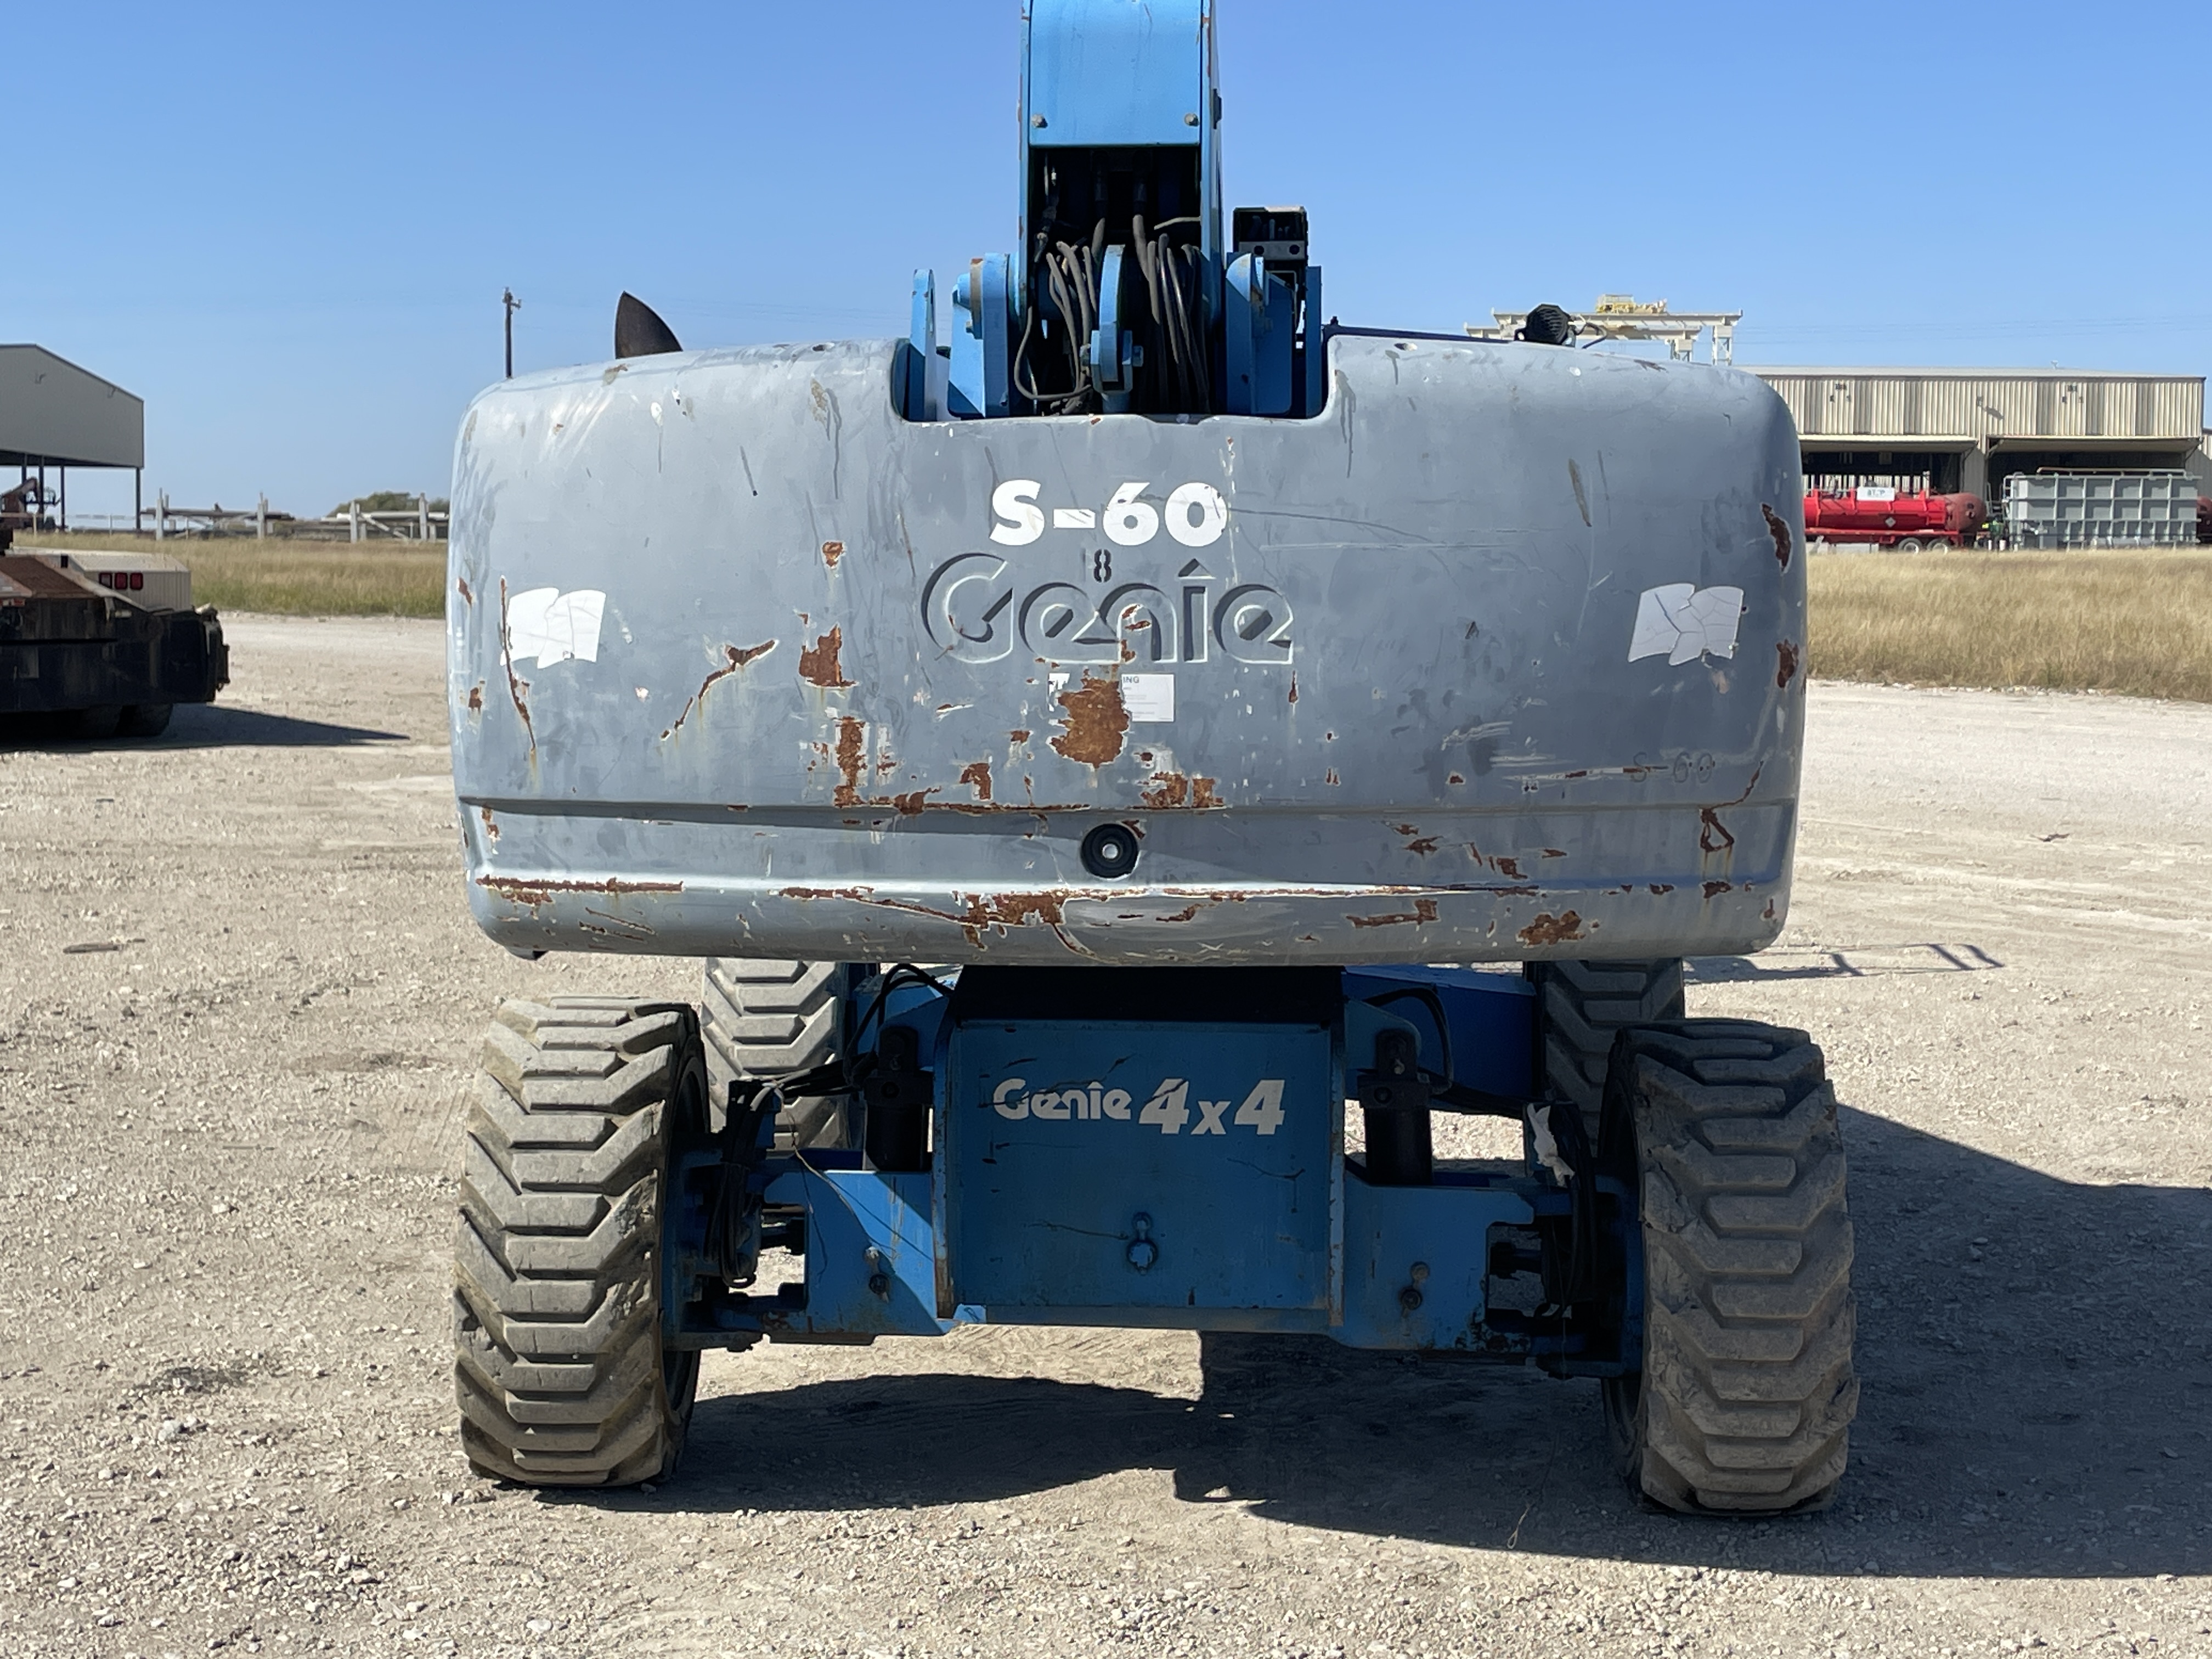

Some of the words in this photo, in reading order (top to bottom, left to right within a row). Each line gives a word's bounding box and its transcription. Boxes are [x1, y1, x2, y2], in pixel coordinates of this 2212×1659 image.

[989, 479, 1228, 547] S-60
[1094, 549, 1111, 583] 8
[921, 552, 1294, 663] Genie
[993, 1077, 1132, 1120] Genie
[1138, 1078, 1285, 1135] 4x4
